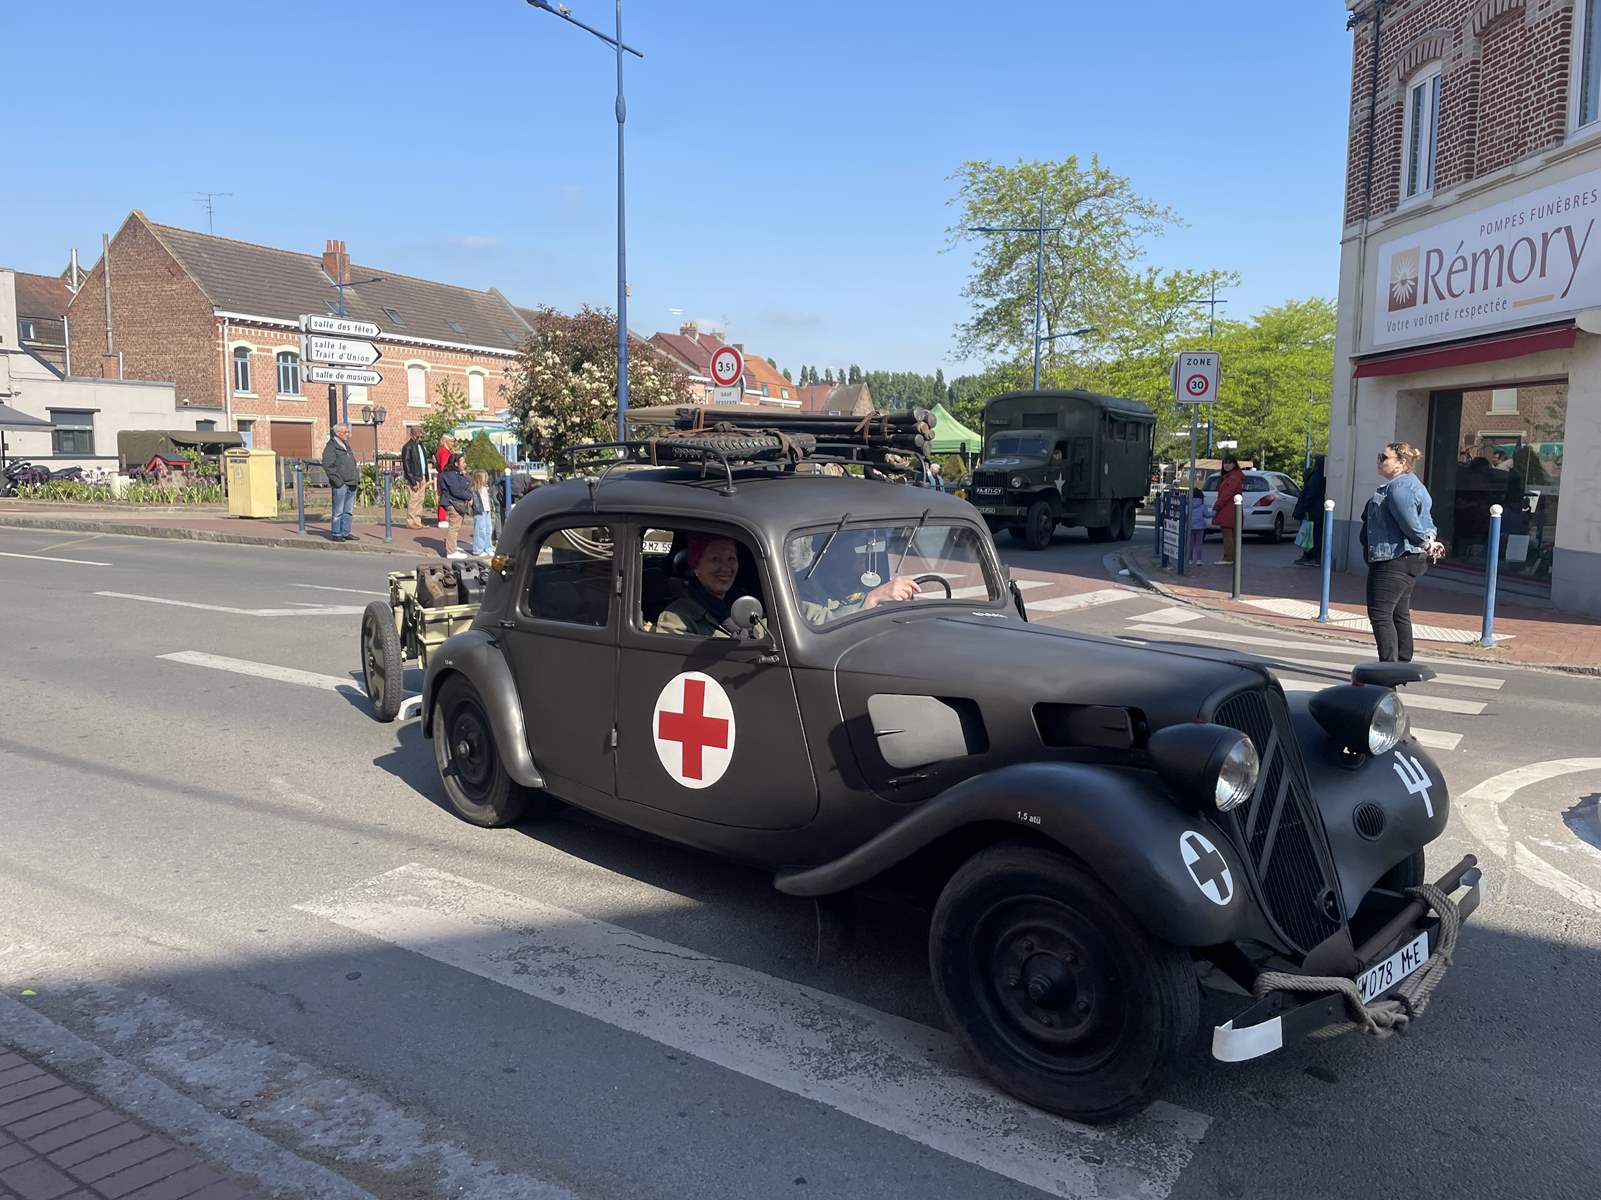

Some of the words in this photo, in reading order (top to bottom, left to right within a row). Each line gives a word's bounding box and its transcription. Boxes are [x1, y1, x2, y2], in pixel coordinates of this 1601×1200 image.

[1479, 212, 1526, 237] POMPES
[1530, 188, 1598, 222] FUNÈBRES
[1422, 218, 1596, 305] Rémory
[1386, 318, 1411, 333] Votre
[1413, 308, 1450, 326] volonté
[1454, 296, 1508, 321] respectée
[313, 320, 334, 329] salle
[337, 322, 351, 331] des
[354, 324, 374, 334] fêtes
[314, 341, 335, 349] salle
[339, 342, 347, 351] le
[315, 350, 335, 359] Trait
[339, 353, 370, 362] d'Union
[1186, 358, 1212, 366] ZONE
[315, 370, 333, 379] salle
[336, 372, 345, 380] de
[346, 373, 375, 382] musique
[1191, 380, 1204, 390] 30
[1017, 811, 1028, 821] 1,5
